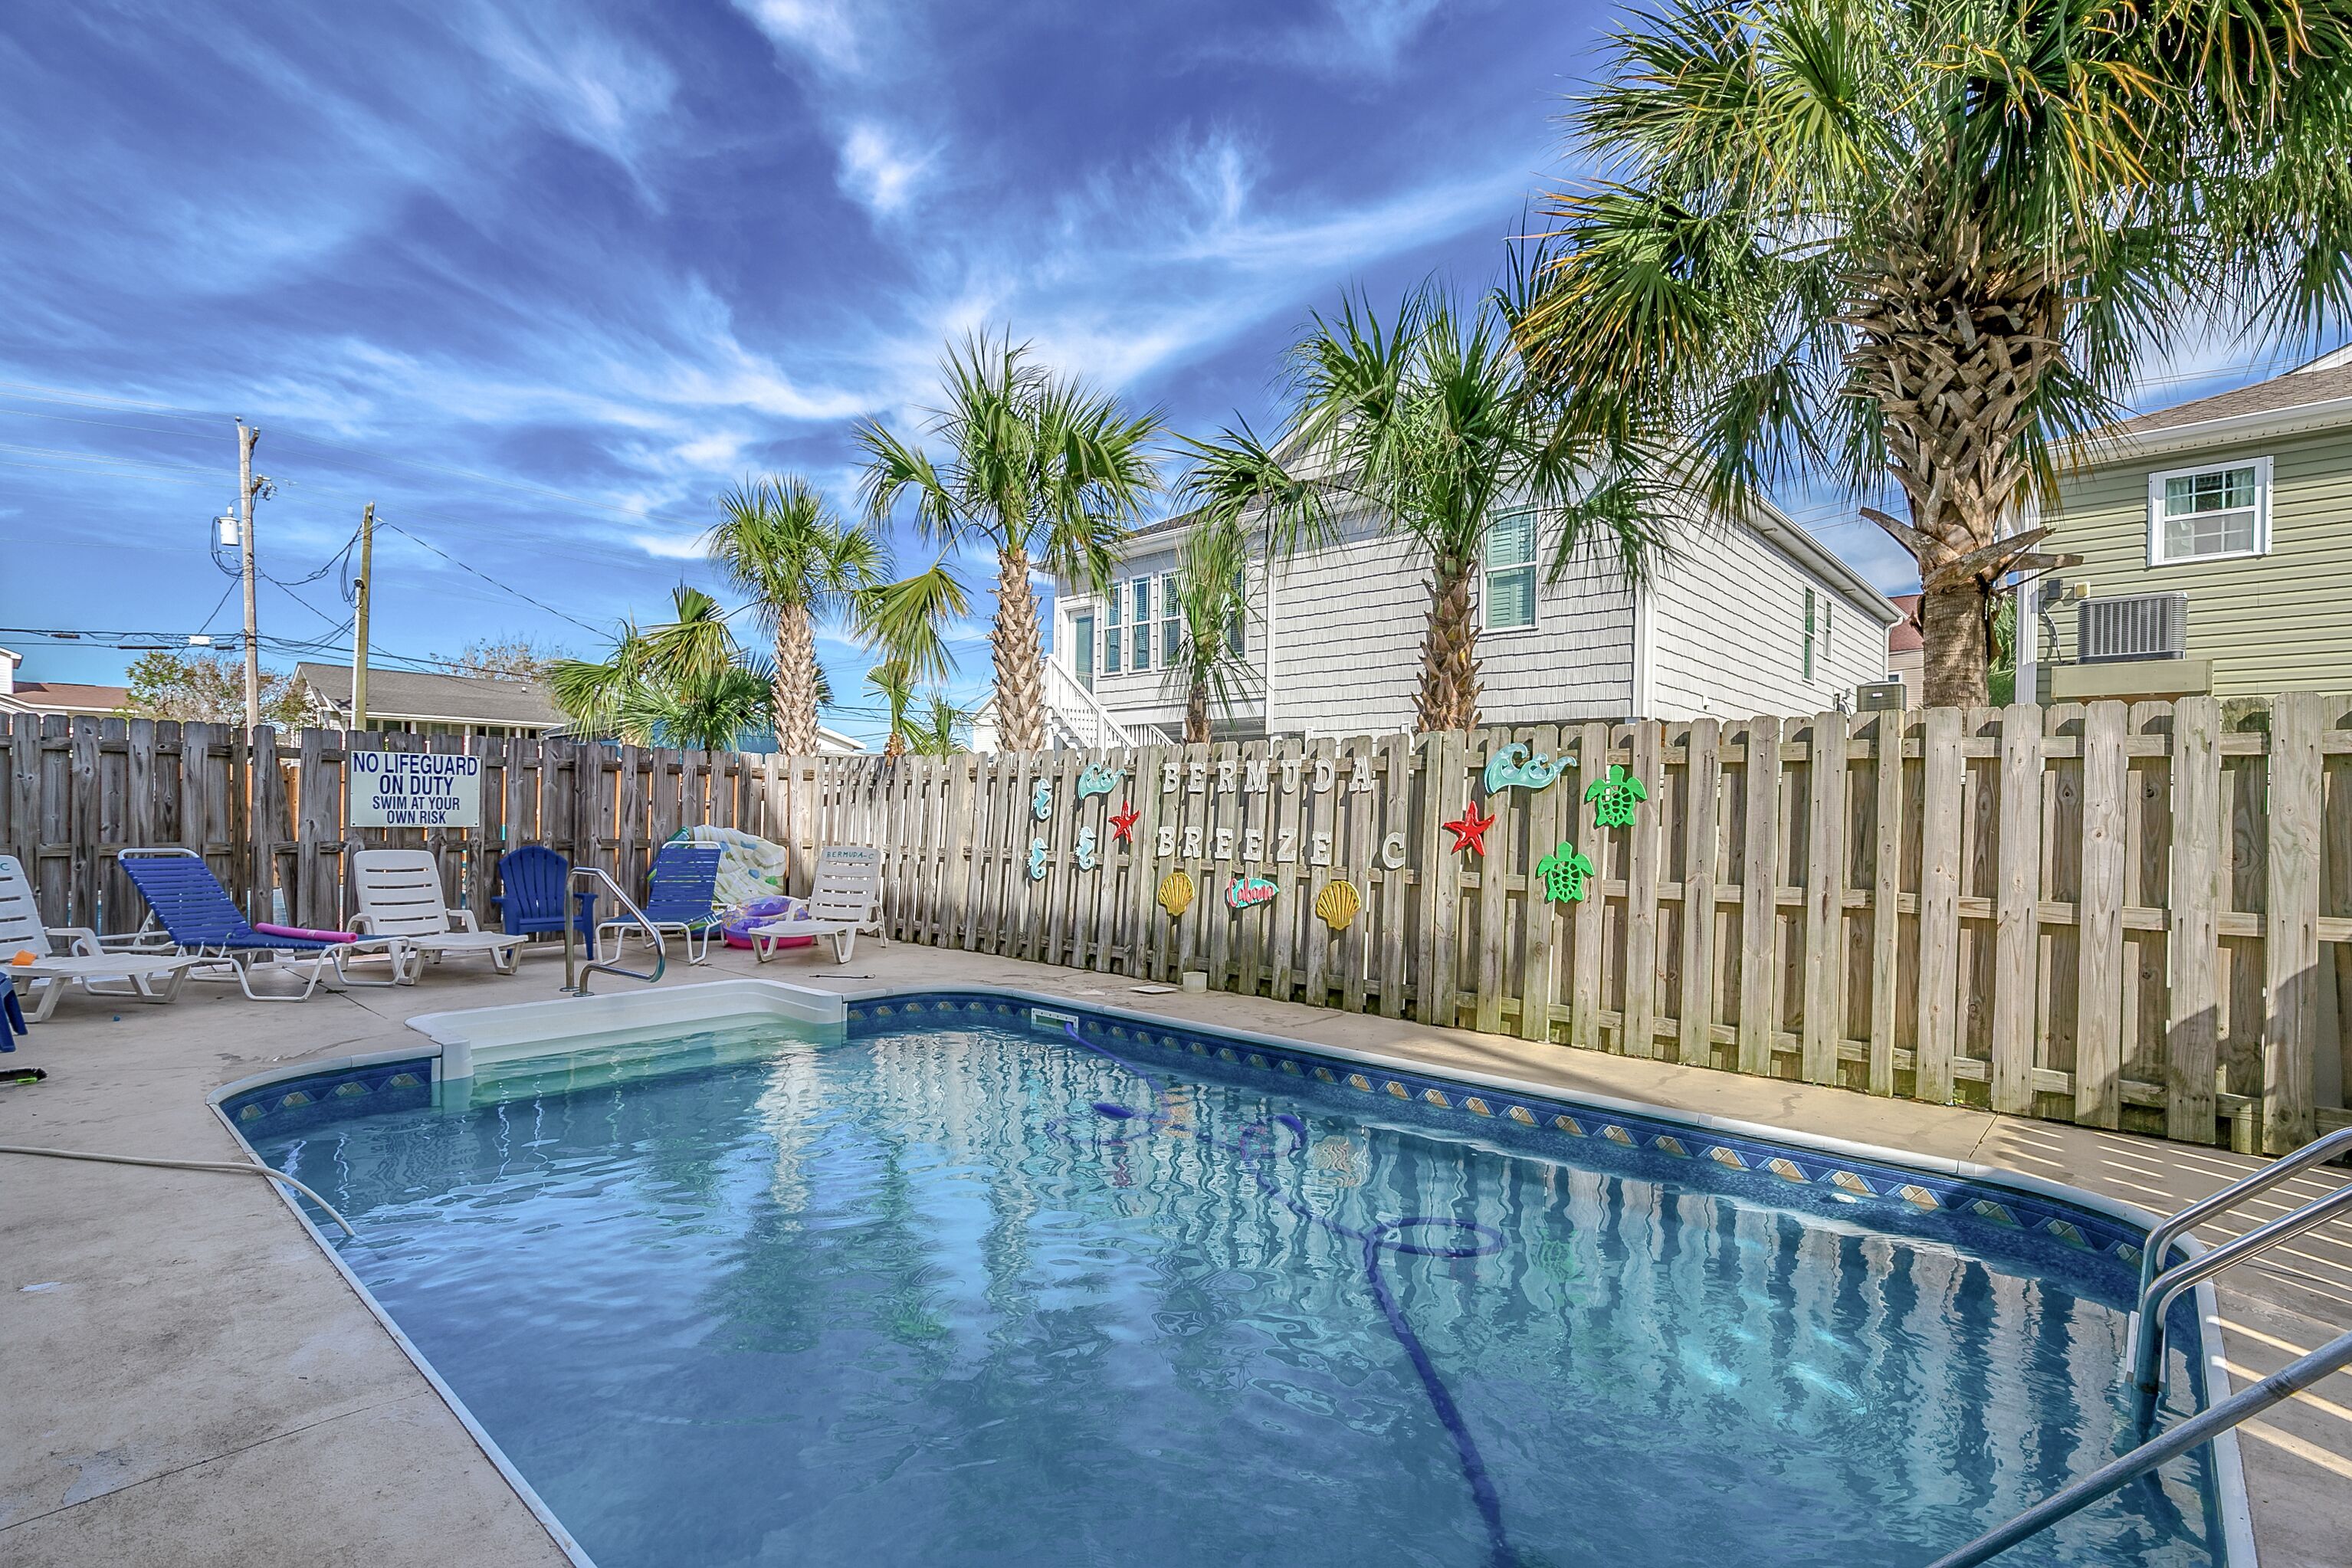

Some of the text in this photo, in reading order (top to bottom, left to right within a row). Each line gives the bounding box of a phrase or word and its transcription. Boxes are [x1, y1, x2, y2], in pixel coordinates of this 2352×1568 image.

[353, 753, 477, 776] NO LIFEGUARD
[1163, 755, 1373, 794] BERMUDA
[380, 775, 454, 795] ON DUTY
[372, 796, 460, 810] SWIM AT YOUR
[387, 810, 446, 824] OWN RISK
[1158, 825, 1406, 869] BREEZE C
[1228, 877, 1274, 907] Cabana
